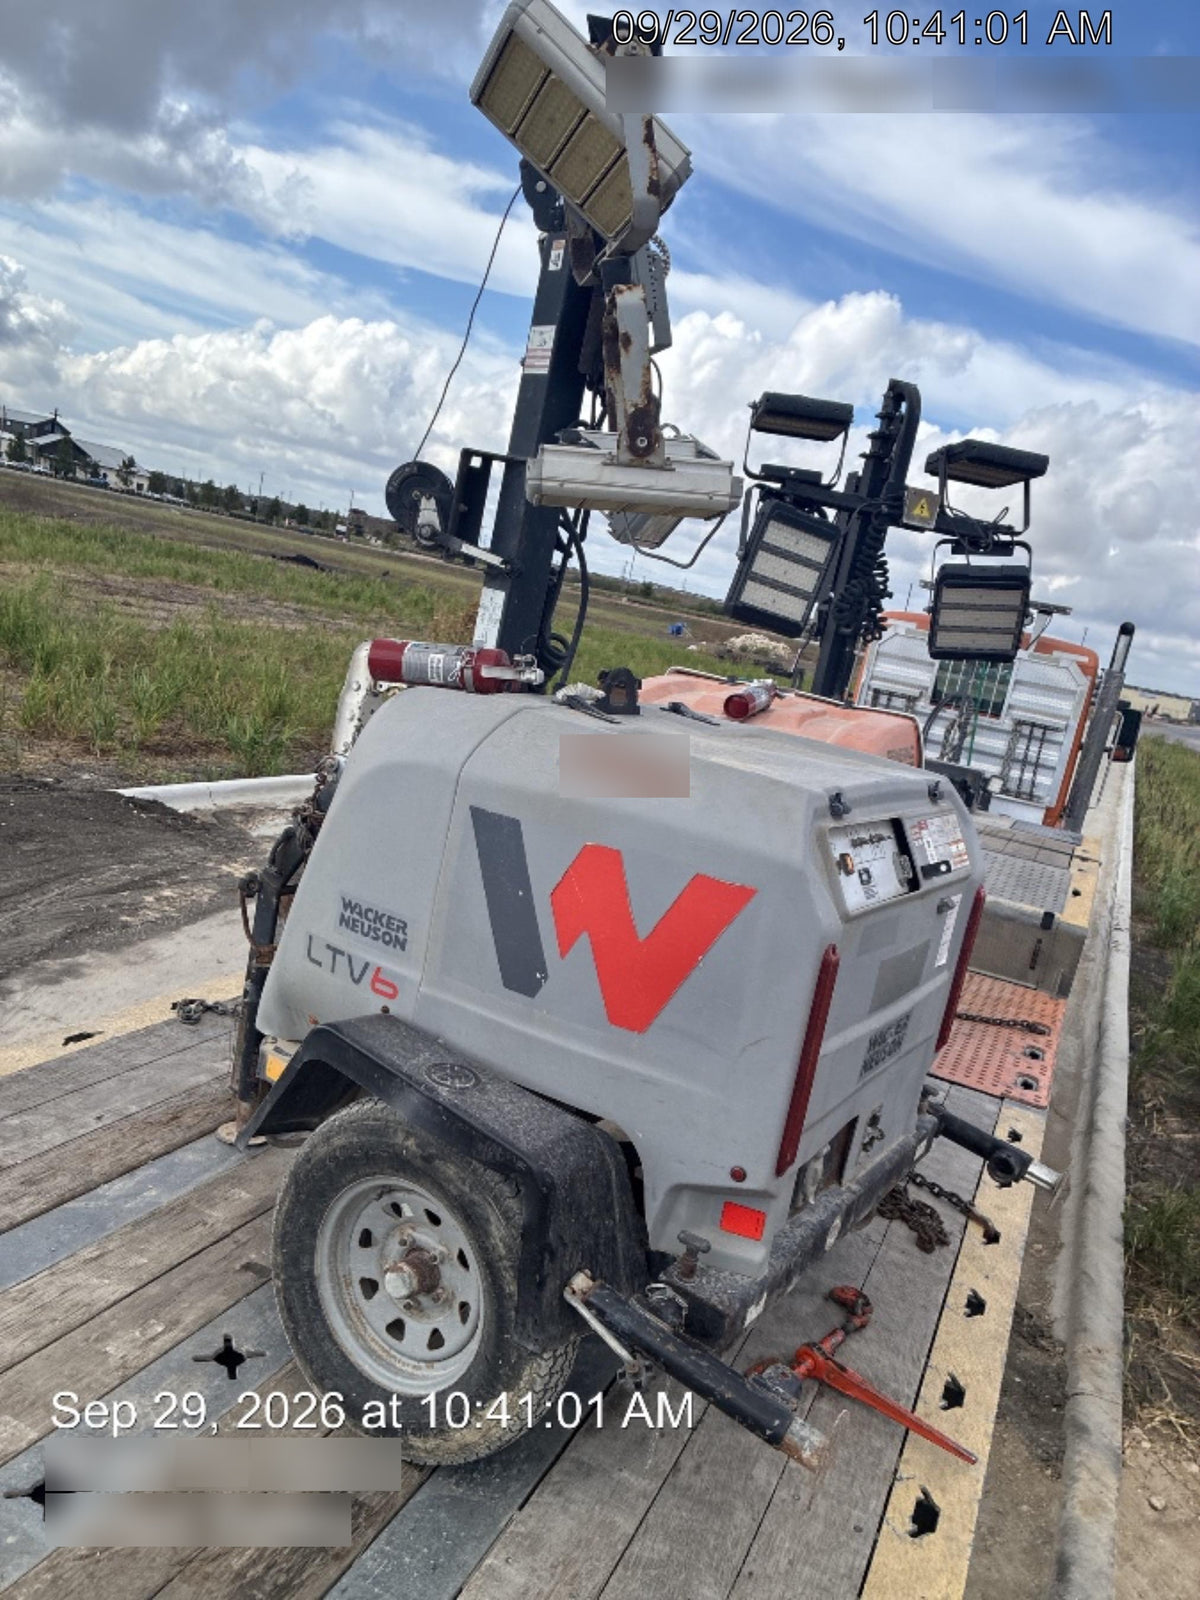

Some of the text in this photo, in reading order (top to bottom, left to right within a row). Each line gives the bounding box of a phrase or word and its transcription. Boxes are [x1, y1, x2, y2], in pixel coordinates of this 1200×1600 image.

[339, 912, 408, 952] NEUSON
[341, 896, 408, 936] WACKER
[307, 935, 399, 1000] LTV6
